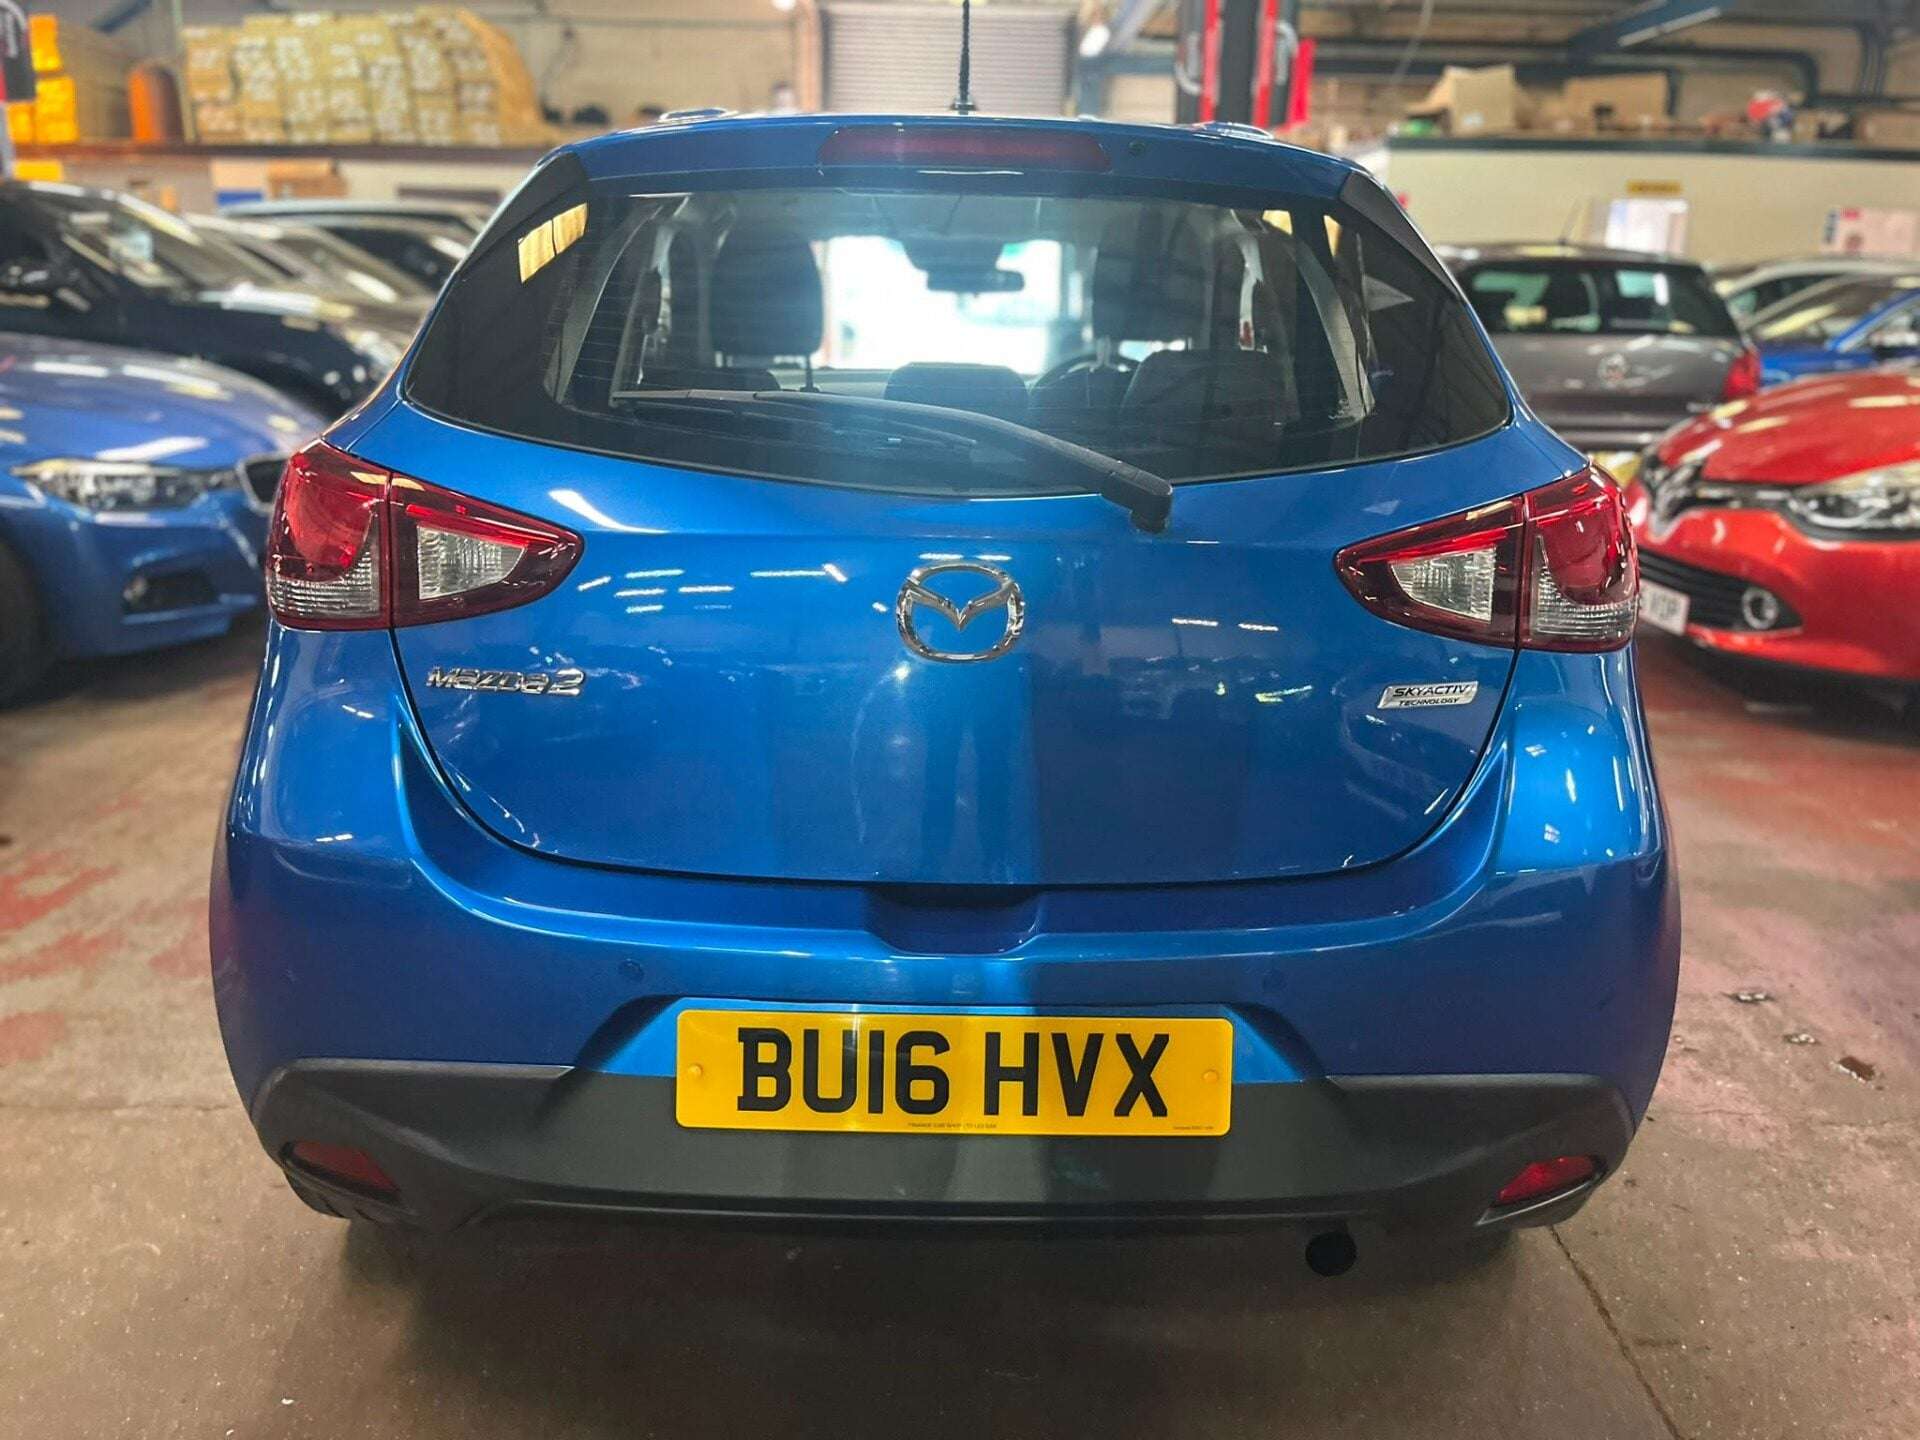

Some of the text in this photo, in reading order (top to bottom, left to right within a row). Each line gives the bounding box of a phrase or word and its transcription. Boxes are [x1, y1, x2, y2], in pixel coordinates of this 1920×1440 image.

[1393, 685, 1470, 697] SKYACTIV
[1398, 697, 1460, 707] TECHNOLOGY
[737, 1027, 1170, 1117] BU16 HVX
